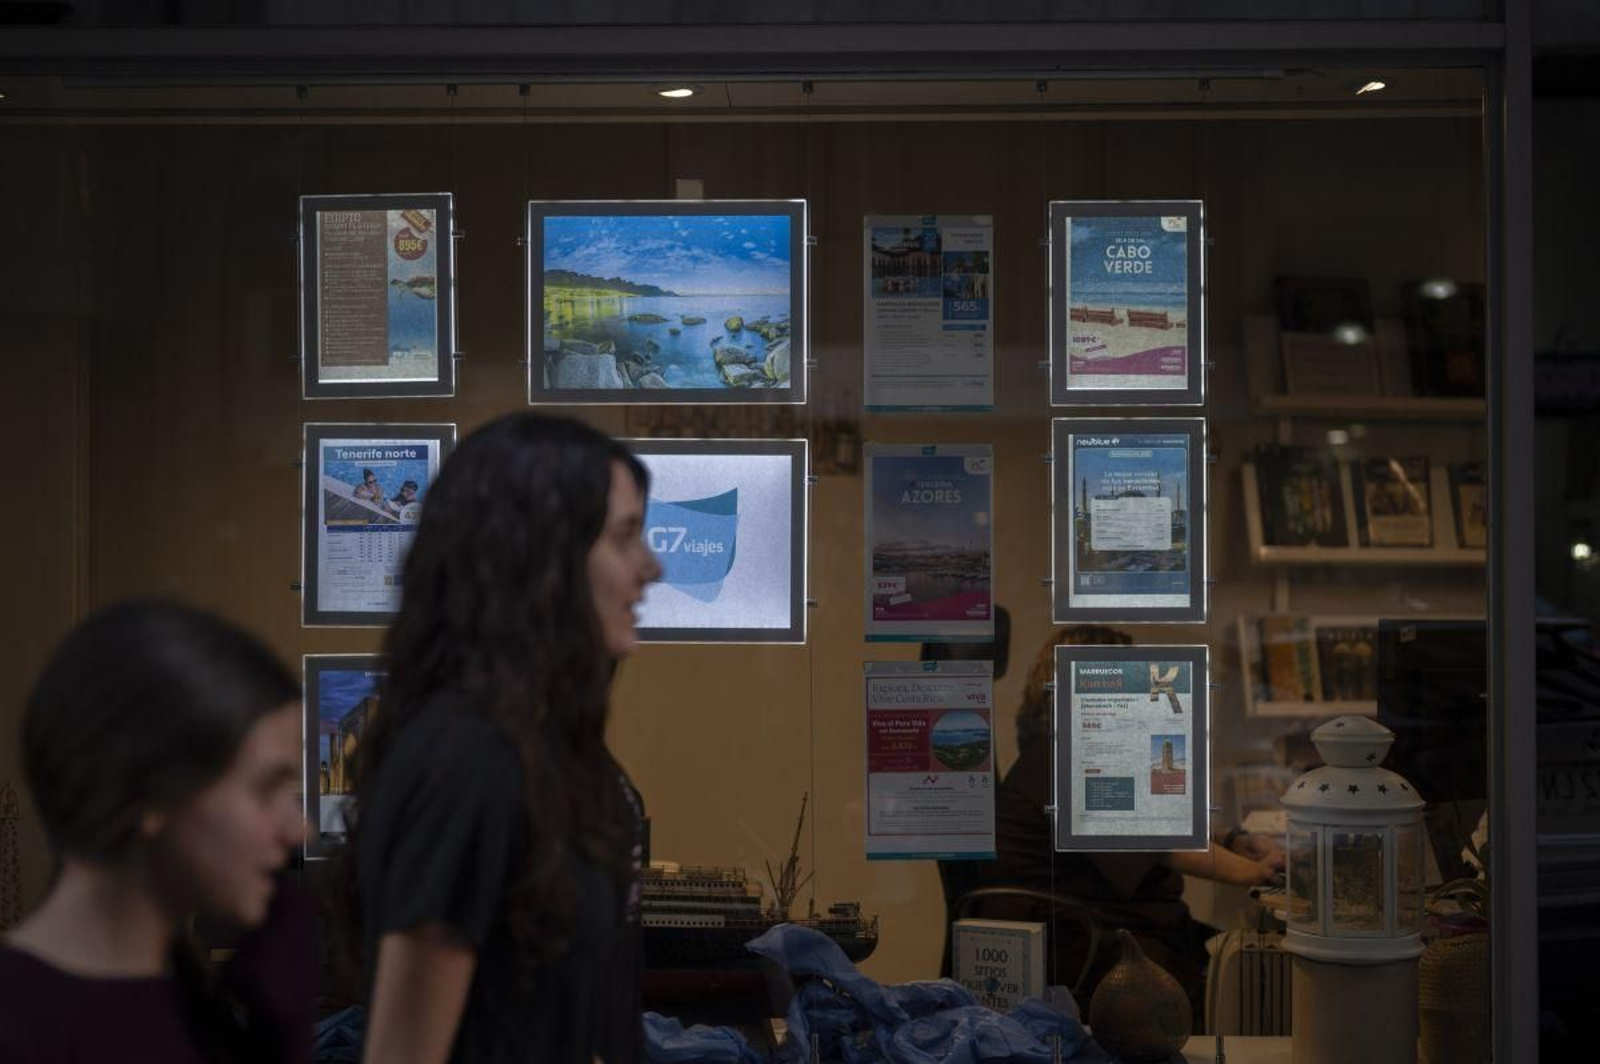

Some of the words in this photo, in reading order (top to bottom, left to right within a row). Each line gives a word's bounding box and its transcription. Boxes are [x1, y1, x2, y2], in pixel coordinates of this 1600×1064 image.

[1106, 245, 1151, 259] CABO
[1104, 260, 1152, 274] VERDE
[336, 449, 382, 459] Tenerife
[384, 449, 417, 458] norte
[901, 490, 962, 503] AZORES
[648, 526, 688, 553] G7
[684, 538, 724, 557] viajes
